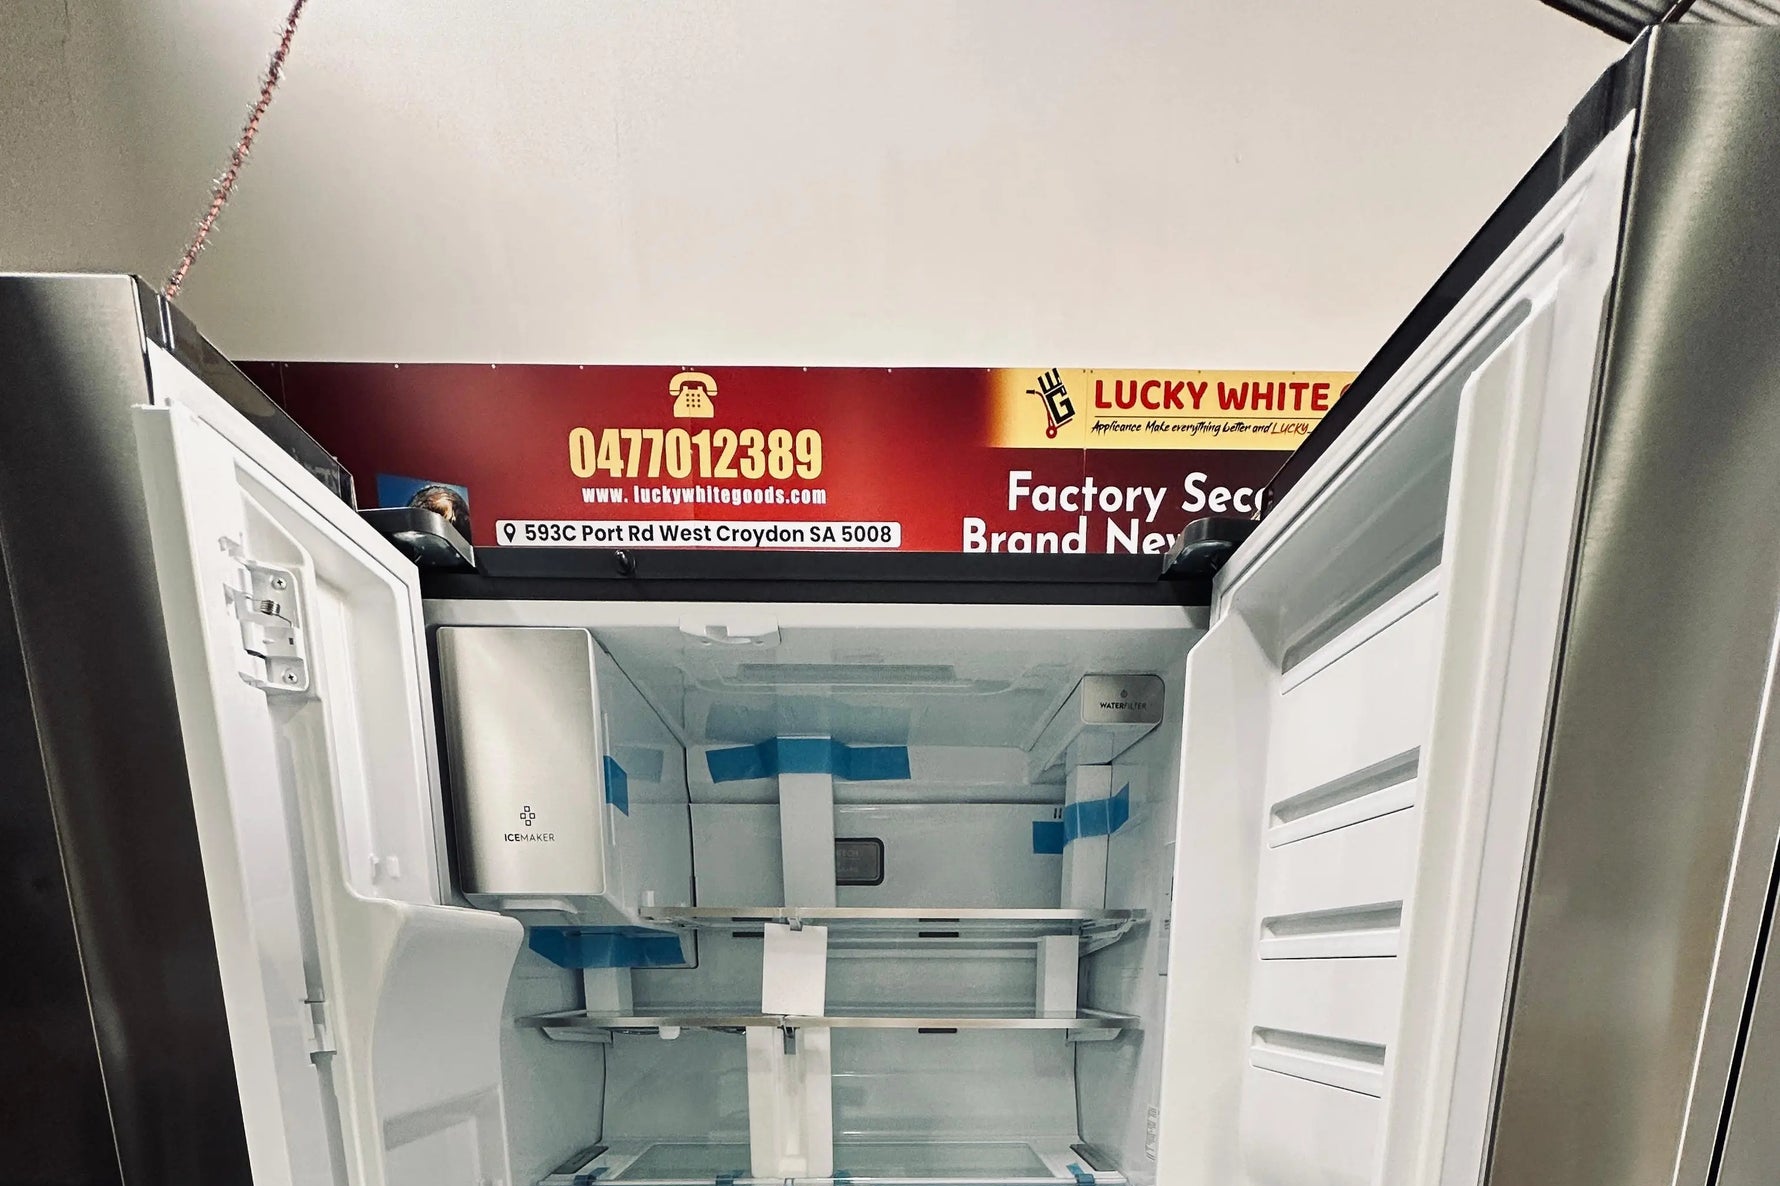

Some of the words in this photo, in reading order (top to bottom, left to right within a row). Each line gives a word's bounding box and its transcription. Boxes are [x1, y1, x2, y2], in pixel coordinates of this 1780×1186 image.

[1095, 379, 1208, 410] LUCKY
[1217, 381, 1331, 411] WHITE
[1145, 420, 1170, 433] Make
[1171, 421, 1221, 436] everything
[1222, 422, 1251, 433] better
[1252, 422, 1273, 433] and
[569, 427, 823, 480] 0477012389
[582, 487, 628, 503] www.
[633, 485, 827, 505] luckywhitegoods.com
[1008, 470, 1167, 523] Factory
[525, 524, 576, 541] 593C
[582, 525, 624, 542] Port
[629, 524, 653, 542] Rd
[660, 525, 711, 542] West
[716, 525, 804, 547] Croydon
[810, 526, 836, 542] SA
[842, 526, 892, 542] 5008
[963, 515, 1088, 554] Brand
[1100, 702, 1147, 711] WATERFILTER
[504, 833, 555, 842] ICEMAKER
